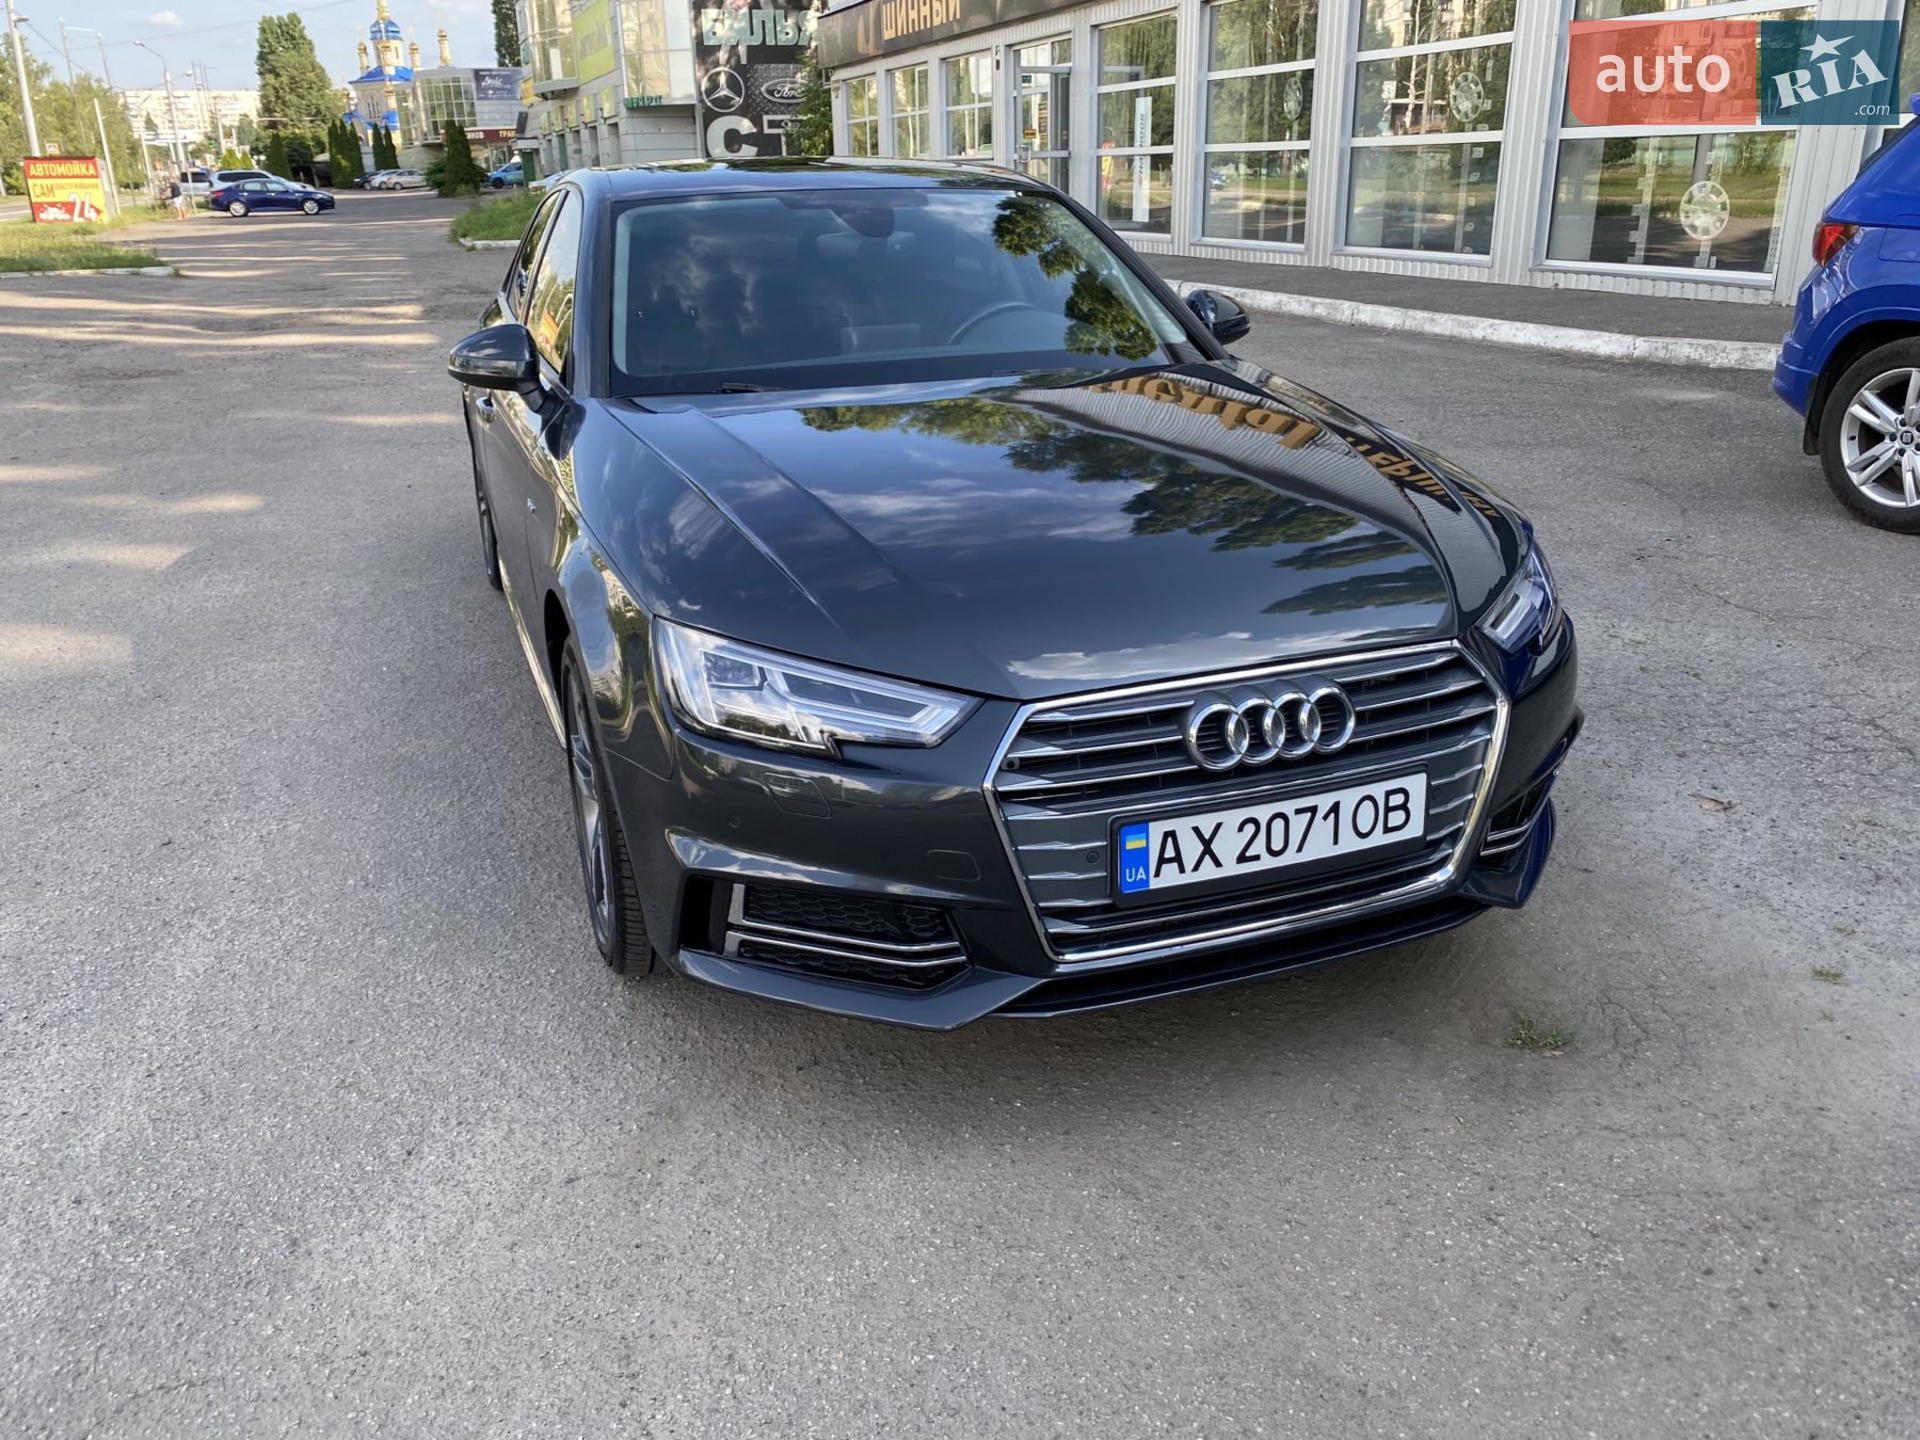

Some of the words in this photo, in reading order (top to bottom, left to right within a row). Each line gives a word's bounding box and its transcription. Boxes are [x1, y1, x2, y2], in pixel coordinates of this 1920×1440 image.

[29, 161, 96, 176] АВТОМОЙКА
[69, 192, 97, 222] 24
[1153, 821, 1224, 878] AX
[1236, 799, 1340, 866] 2071
[1351, 786, 1411, 839] OB
[1125, 867, 1147, 883] UA
